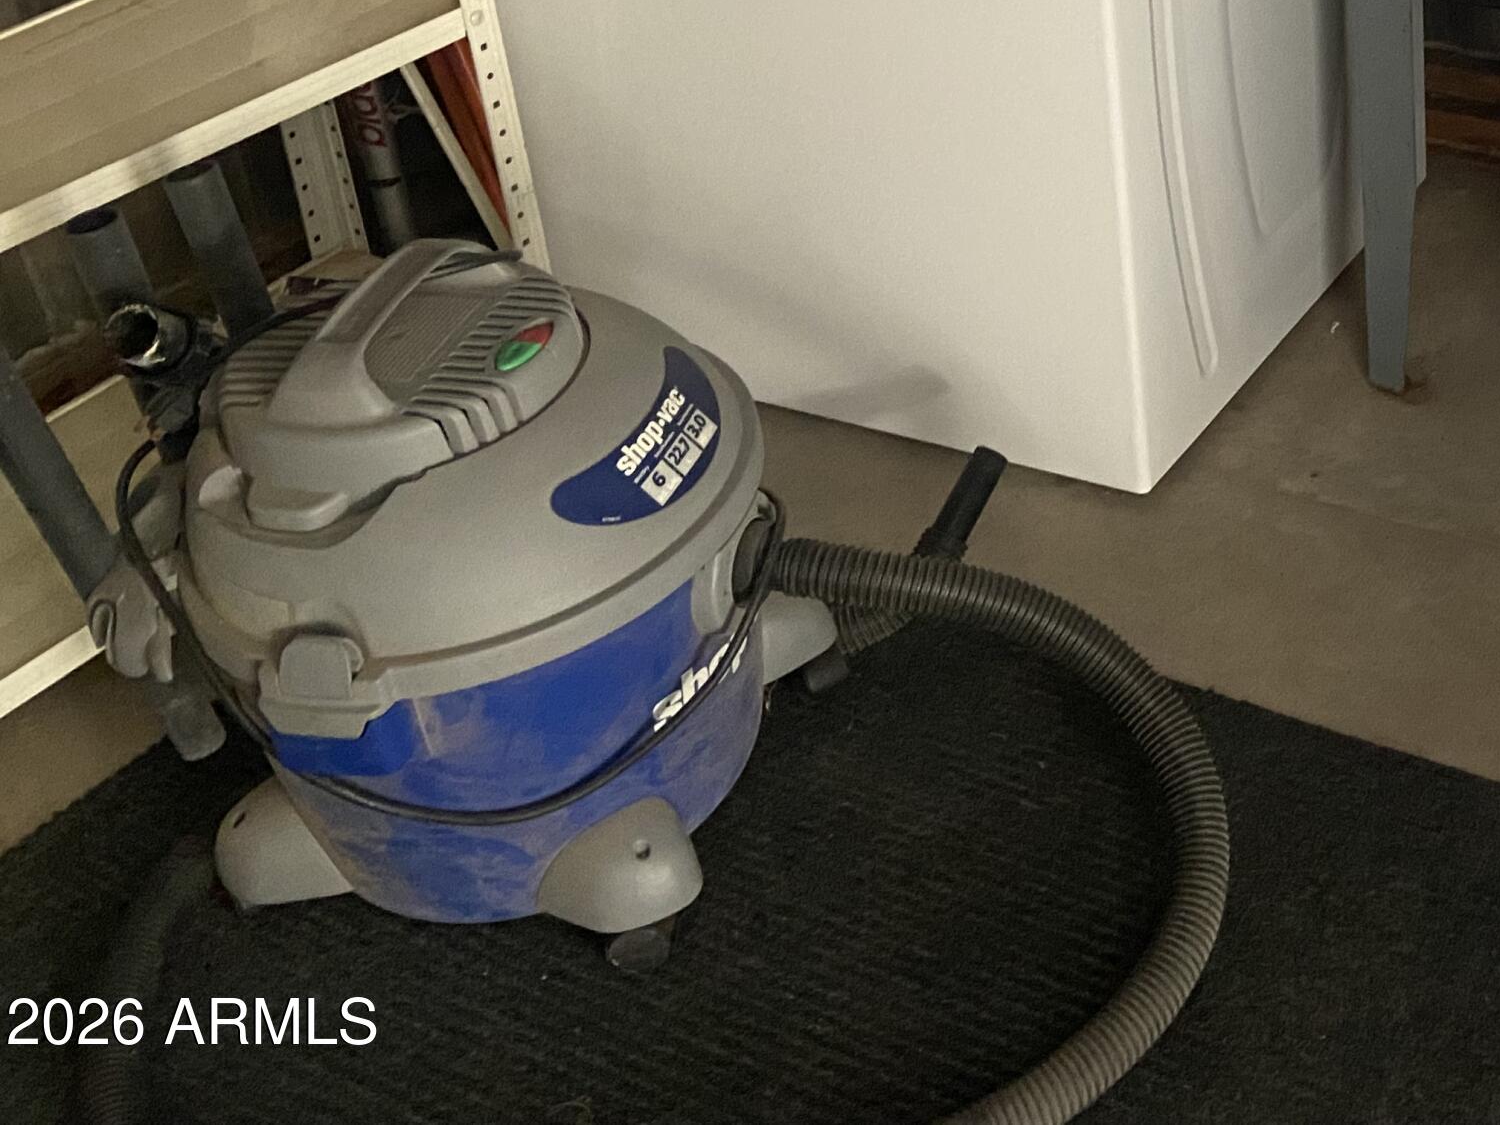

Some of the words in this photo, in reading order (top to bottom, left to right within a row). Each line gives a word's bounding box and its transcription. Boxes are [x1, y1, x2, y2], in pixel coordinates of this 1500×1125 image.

[687, 415, 707, 440] 3.0
[667, 439, 691, 467] 22.7
[651, 472, 666, 487] 6
